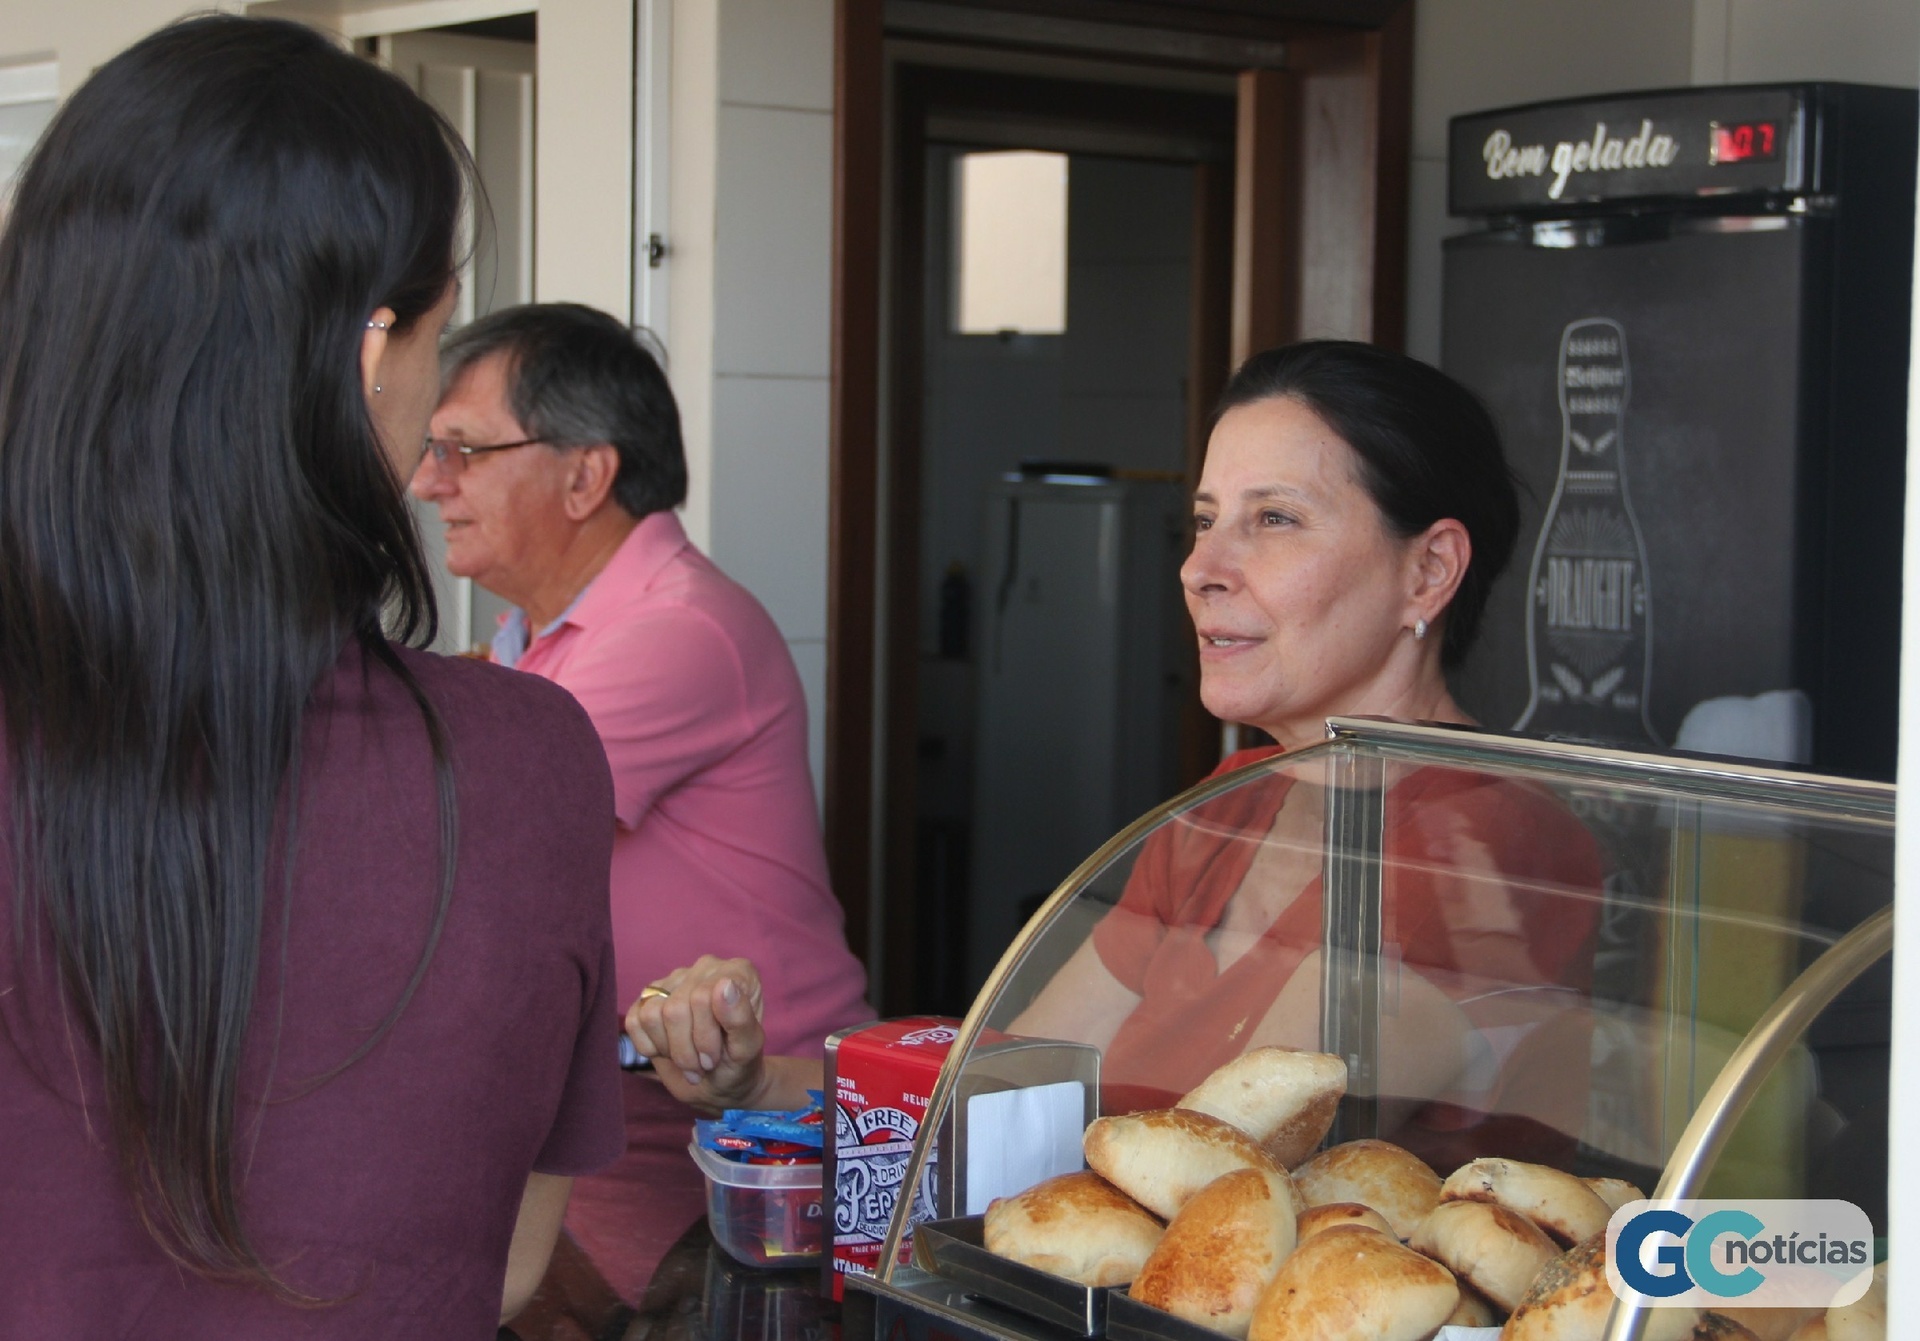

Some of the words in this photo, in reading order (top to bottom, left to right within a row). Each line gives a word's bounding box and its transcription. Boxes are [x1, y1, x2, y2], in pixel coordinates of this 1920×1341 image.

[1548, 118, 1680, 200] gelada
[1547, 556, 1635, 632] DRAUGHT
[862, 1109, 912, 1133] FREE
